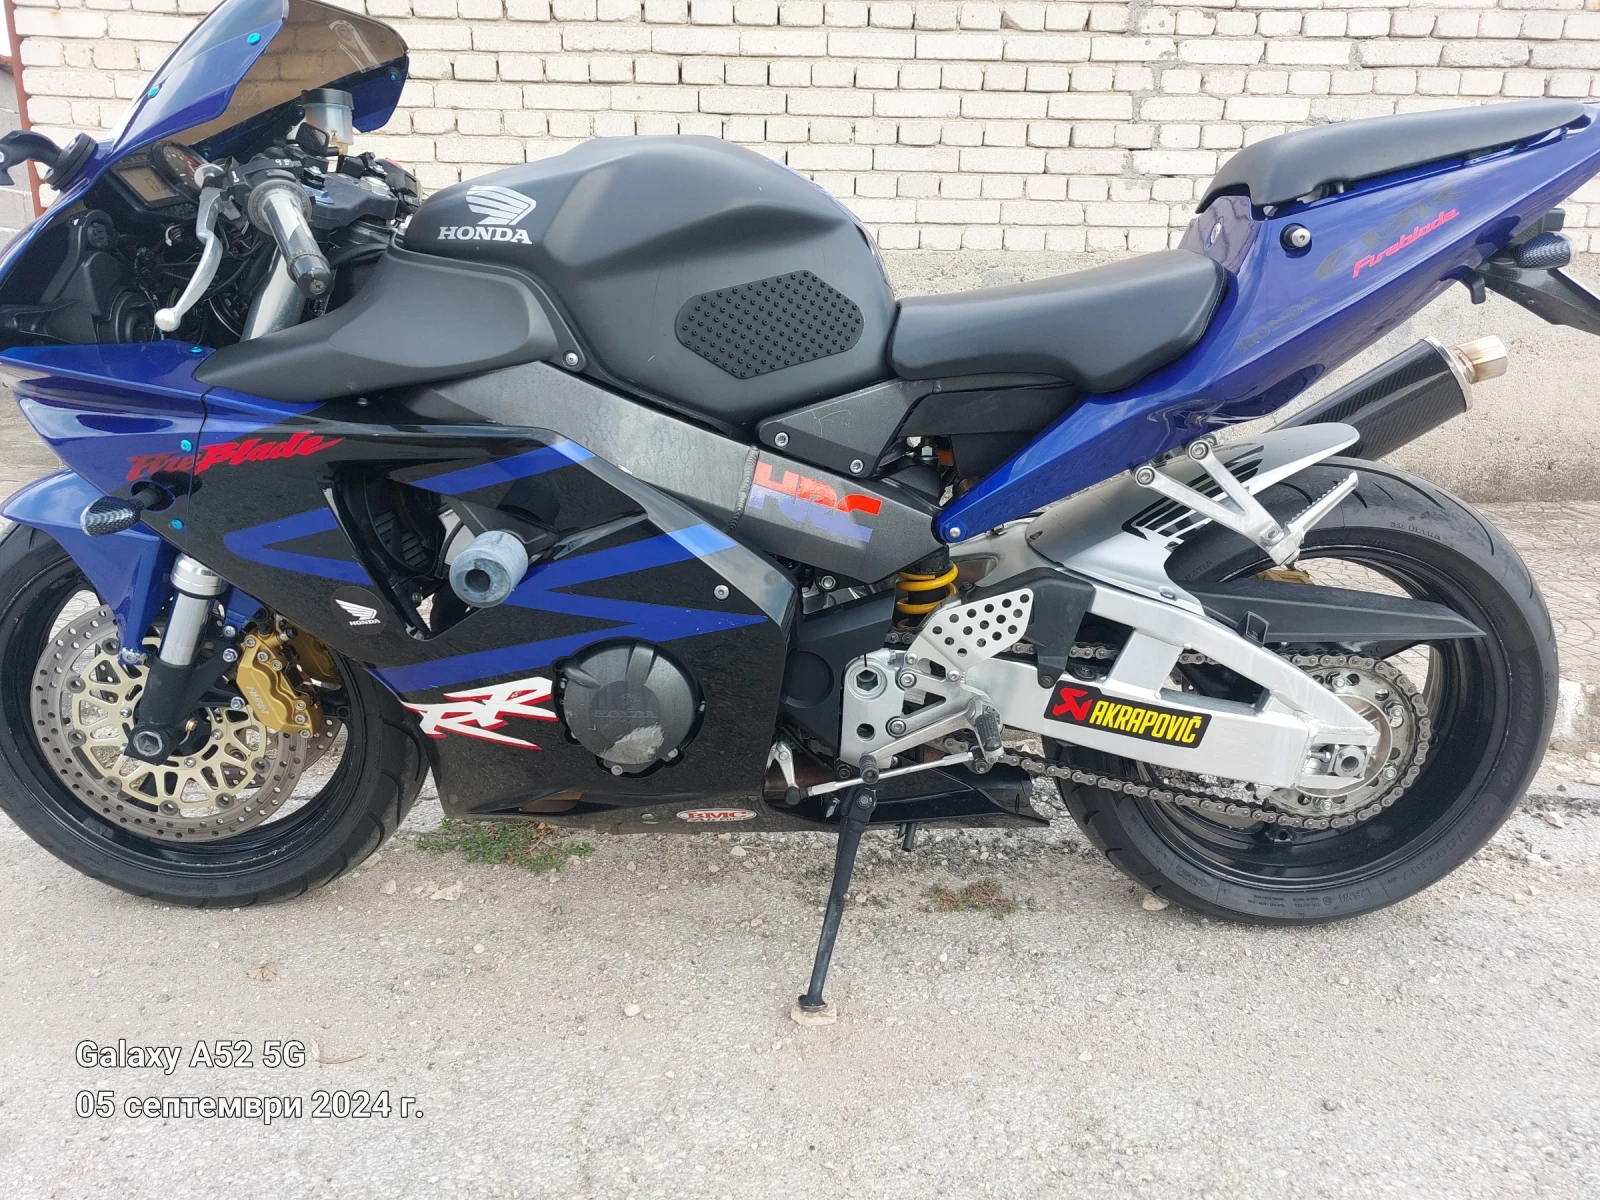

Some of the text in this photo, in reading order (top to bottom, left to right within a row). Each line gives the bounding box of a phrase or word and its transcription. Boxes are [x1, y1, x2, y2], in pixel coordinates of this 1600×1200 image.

[437, 226, 533, 245] HONDA
[1352, 208, 1460, 279] Fireblade
[1236, 297, 1321, 353] HONDA
[748, 461, 882, 543] HRC
[349, 618, 381, 626] HONDA
[687, 811, 747, 819] BMC
